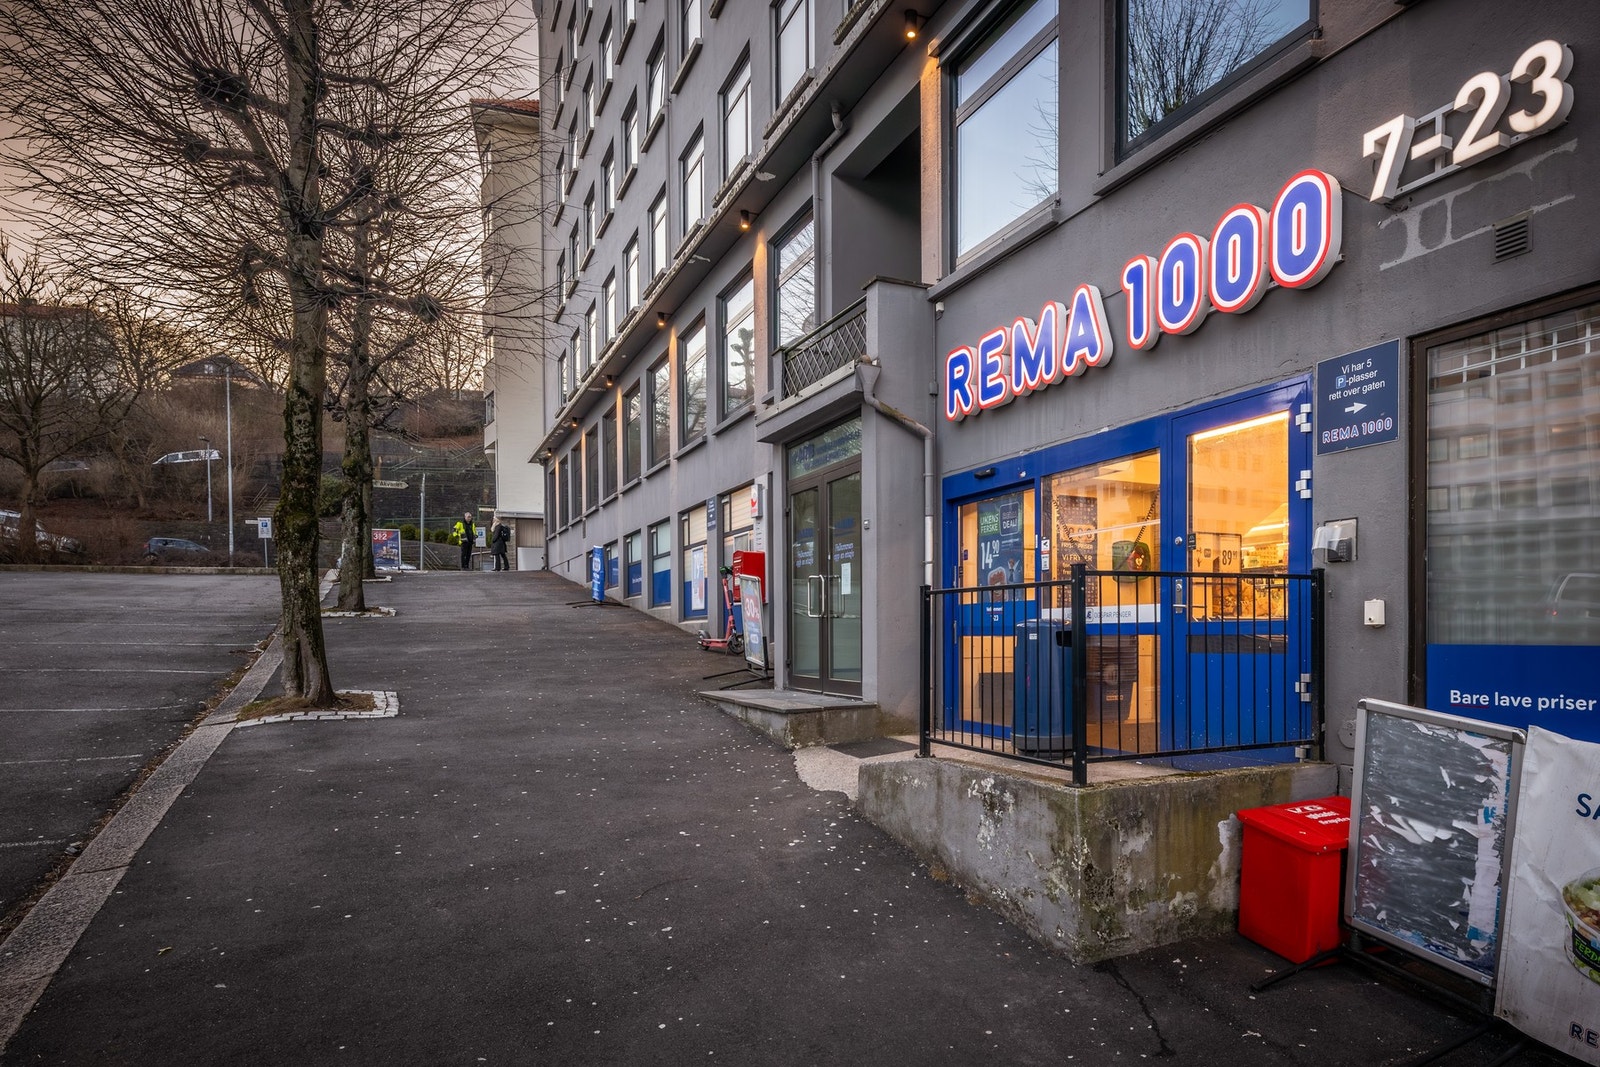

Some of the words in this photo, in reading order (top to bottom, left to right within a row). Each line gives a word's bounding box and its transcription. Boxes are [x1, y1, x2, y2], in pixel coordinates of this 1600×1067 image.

[1363, 39, 1569, 202] 7-23
[945, 283, 1110, 422] REMA
[1121, 168, 1339, 351] 1000
[1342, 364, 1350, 375] Vi
[1351, 361, 1365, 372] har
[1366, 358, 1373, 368] 5
[1328, 390, 1342, 401] rett
[1343, 386, 1361, 397] over
[1362, 380, 1386, 394] gaten
[1322, 424, 1359, 444] REMA
[1361, 417, 1393, 436] 1000
[980, 523, 999, 534] FERSKE
[981, 541, 993, 570] 14
[992, 539, 1000, 554] 90
[1222, 549, 1233, 566] 89
[1450, 690, 1489, 705] Bare
[1494, 692, 1532, 707] lave
[1537, 694, 1597, 711] priser
